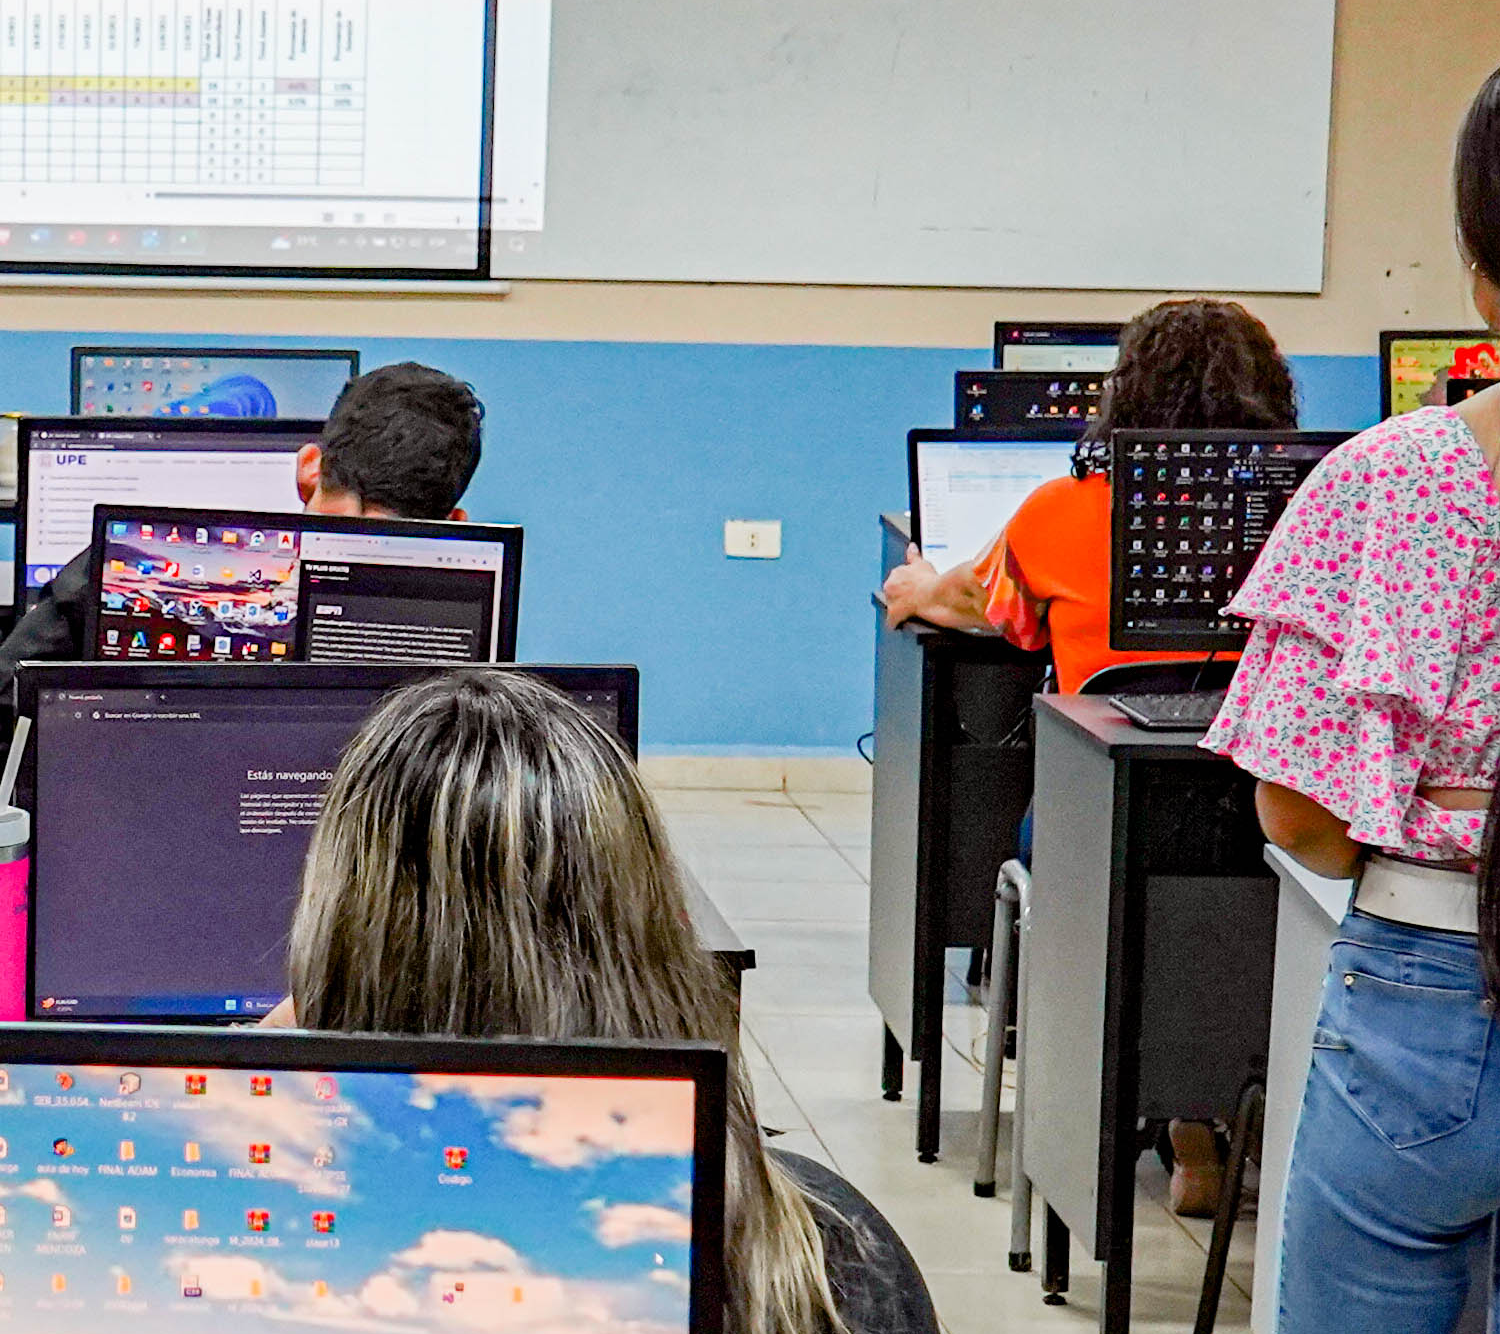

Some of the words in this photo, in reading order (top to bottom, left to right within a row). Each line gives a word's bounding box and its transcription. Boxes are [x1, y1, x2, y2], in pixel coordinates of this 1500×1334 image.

[56, 455, 87, 465] UPE
[248, 770, 273, 780] Estás
[276, 771, 333, 783] navegando
[98, 1166, 124, 1176] FINAL
[128, 1166, 157, 1176] ADAM
